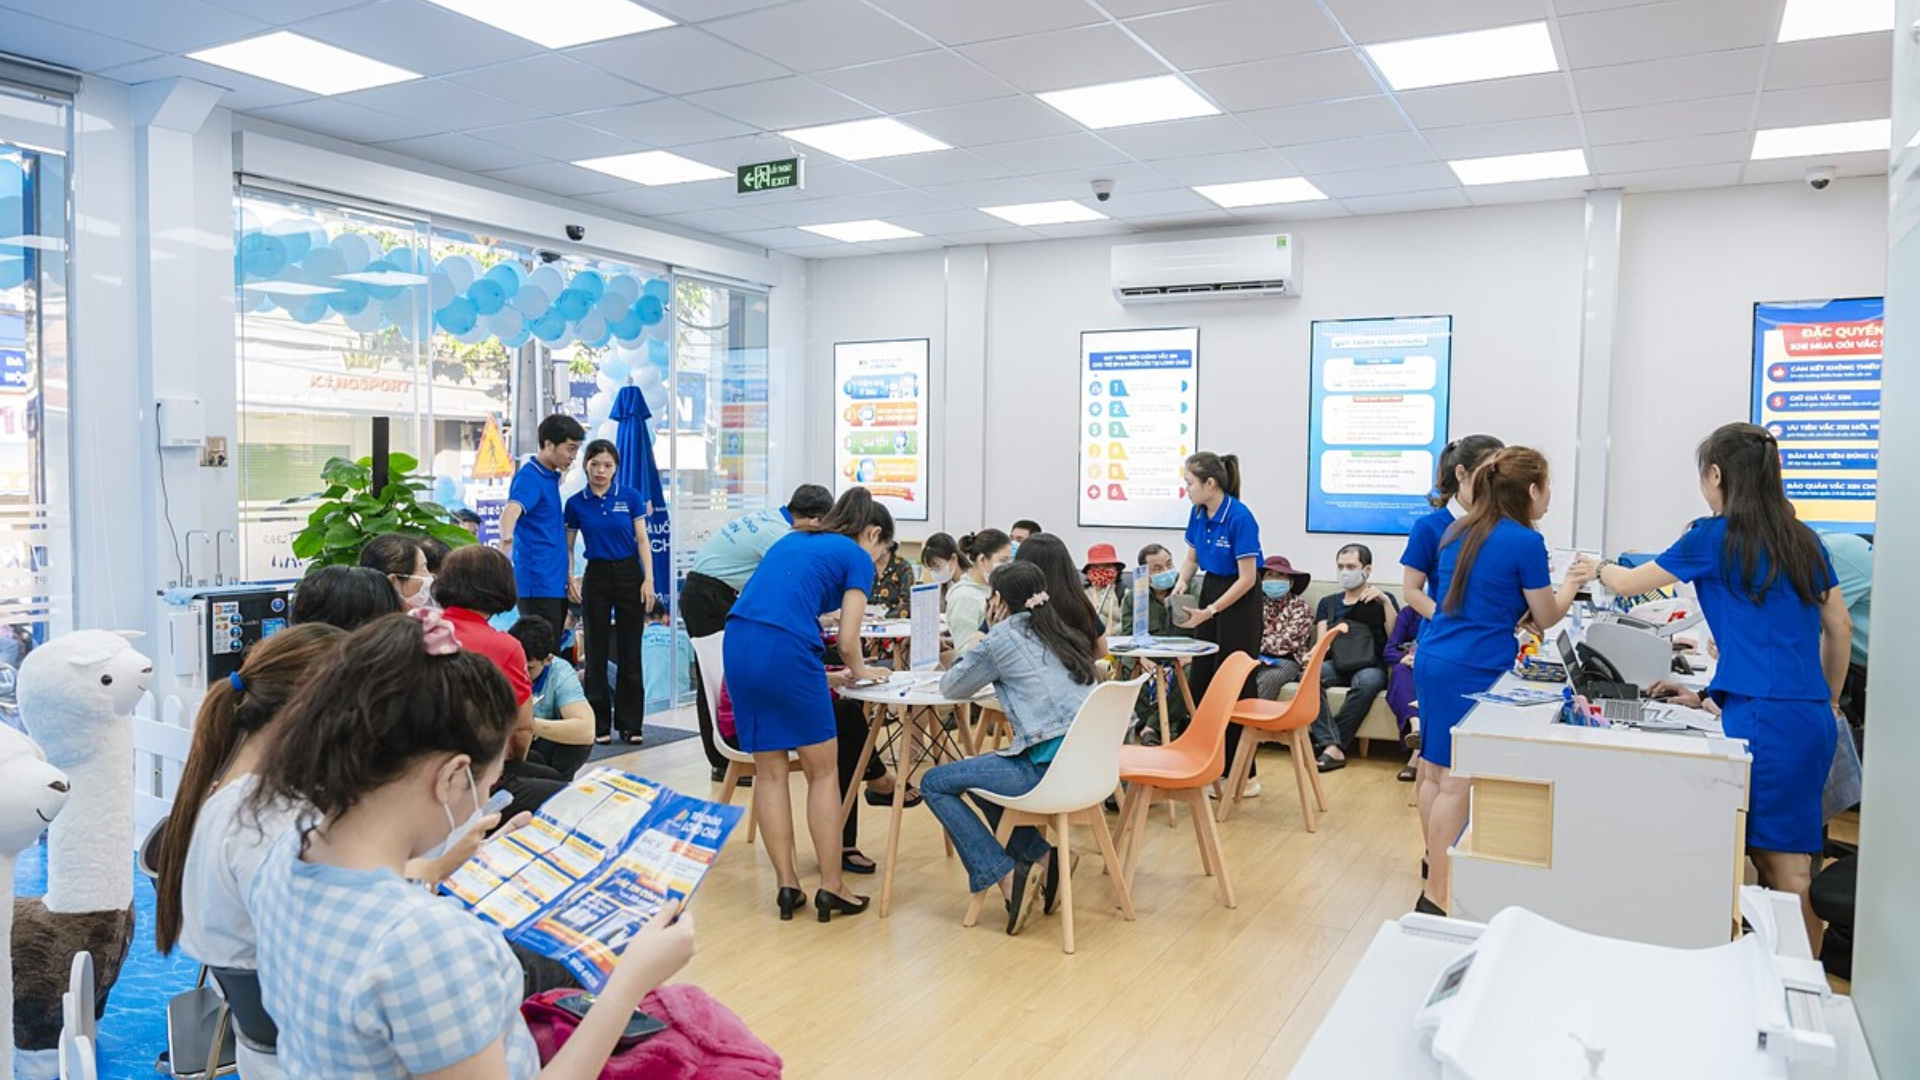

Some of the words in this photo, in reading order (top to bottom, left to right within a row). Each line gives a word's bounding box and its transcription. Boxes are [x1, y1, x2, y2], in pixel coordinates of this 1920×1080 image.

[771, 176, 790, 186] EXIT
[1801, 325, 1832, 339] ĐẶC
[1835, 323, 1883, 338] QUYỀN
[1790, 342, 1809, 350] KHI
[1811, 341, 1834, 349] MUA
[1835, 339, 1854, 348] GÓI
[1856, 338, 1877, 347] VẮC
[1820, 392, 1836, 401] VẮC
[1113, 404, 1120, 414] 2
[1113, 424, 1119, 434] 3
[1819, 422, 1835, 430] VẮC
[1829, 481, 1845, 489] VẮC
